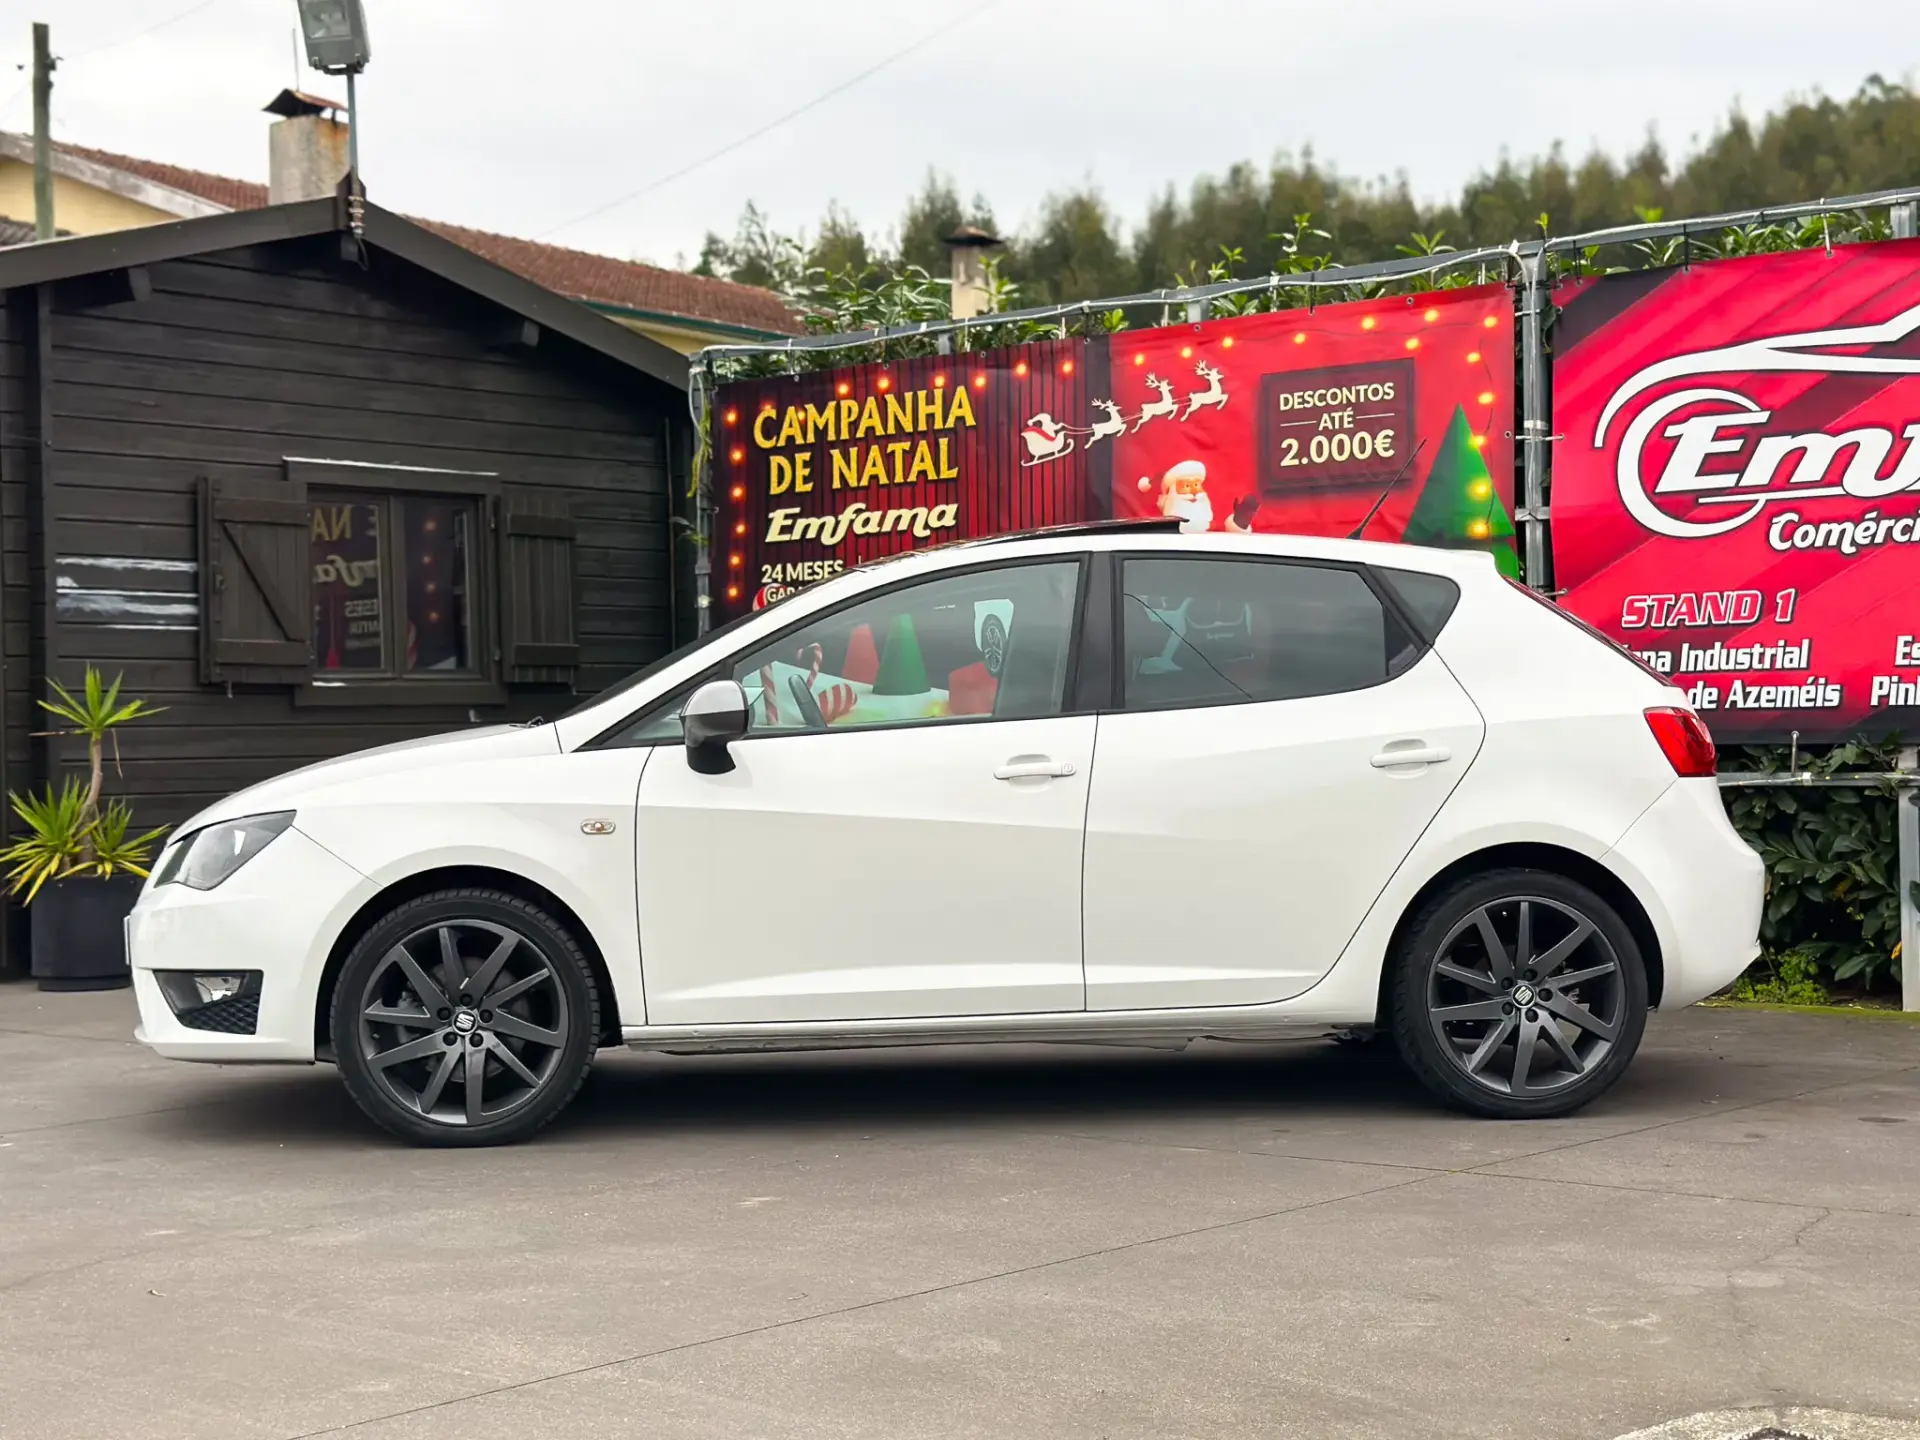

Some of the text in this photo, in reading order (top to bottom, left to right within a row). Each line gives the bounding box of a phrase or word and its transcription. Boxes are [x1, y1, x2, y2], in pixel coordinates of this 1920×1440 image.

[1279, 382, 1395, 411] DESCONTOS
[753, 385, 976, 449] CAMPANHA
[1318, 407, 1354, 431] ATÉ
[1280, 429, 1395, 467] 2.000€
[769, 437, 959, 496] DE NATAL
[765, 501, 959, 546] Emfama
[761, 559, 844, 584] 24 MESES
[1621, 588, 1796, 628] STAND 1
[1679, 638, 1812, 672] Industrial
[1687, 676, 1842, 710] de Azeméis
